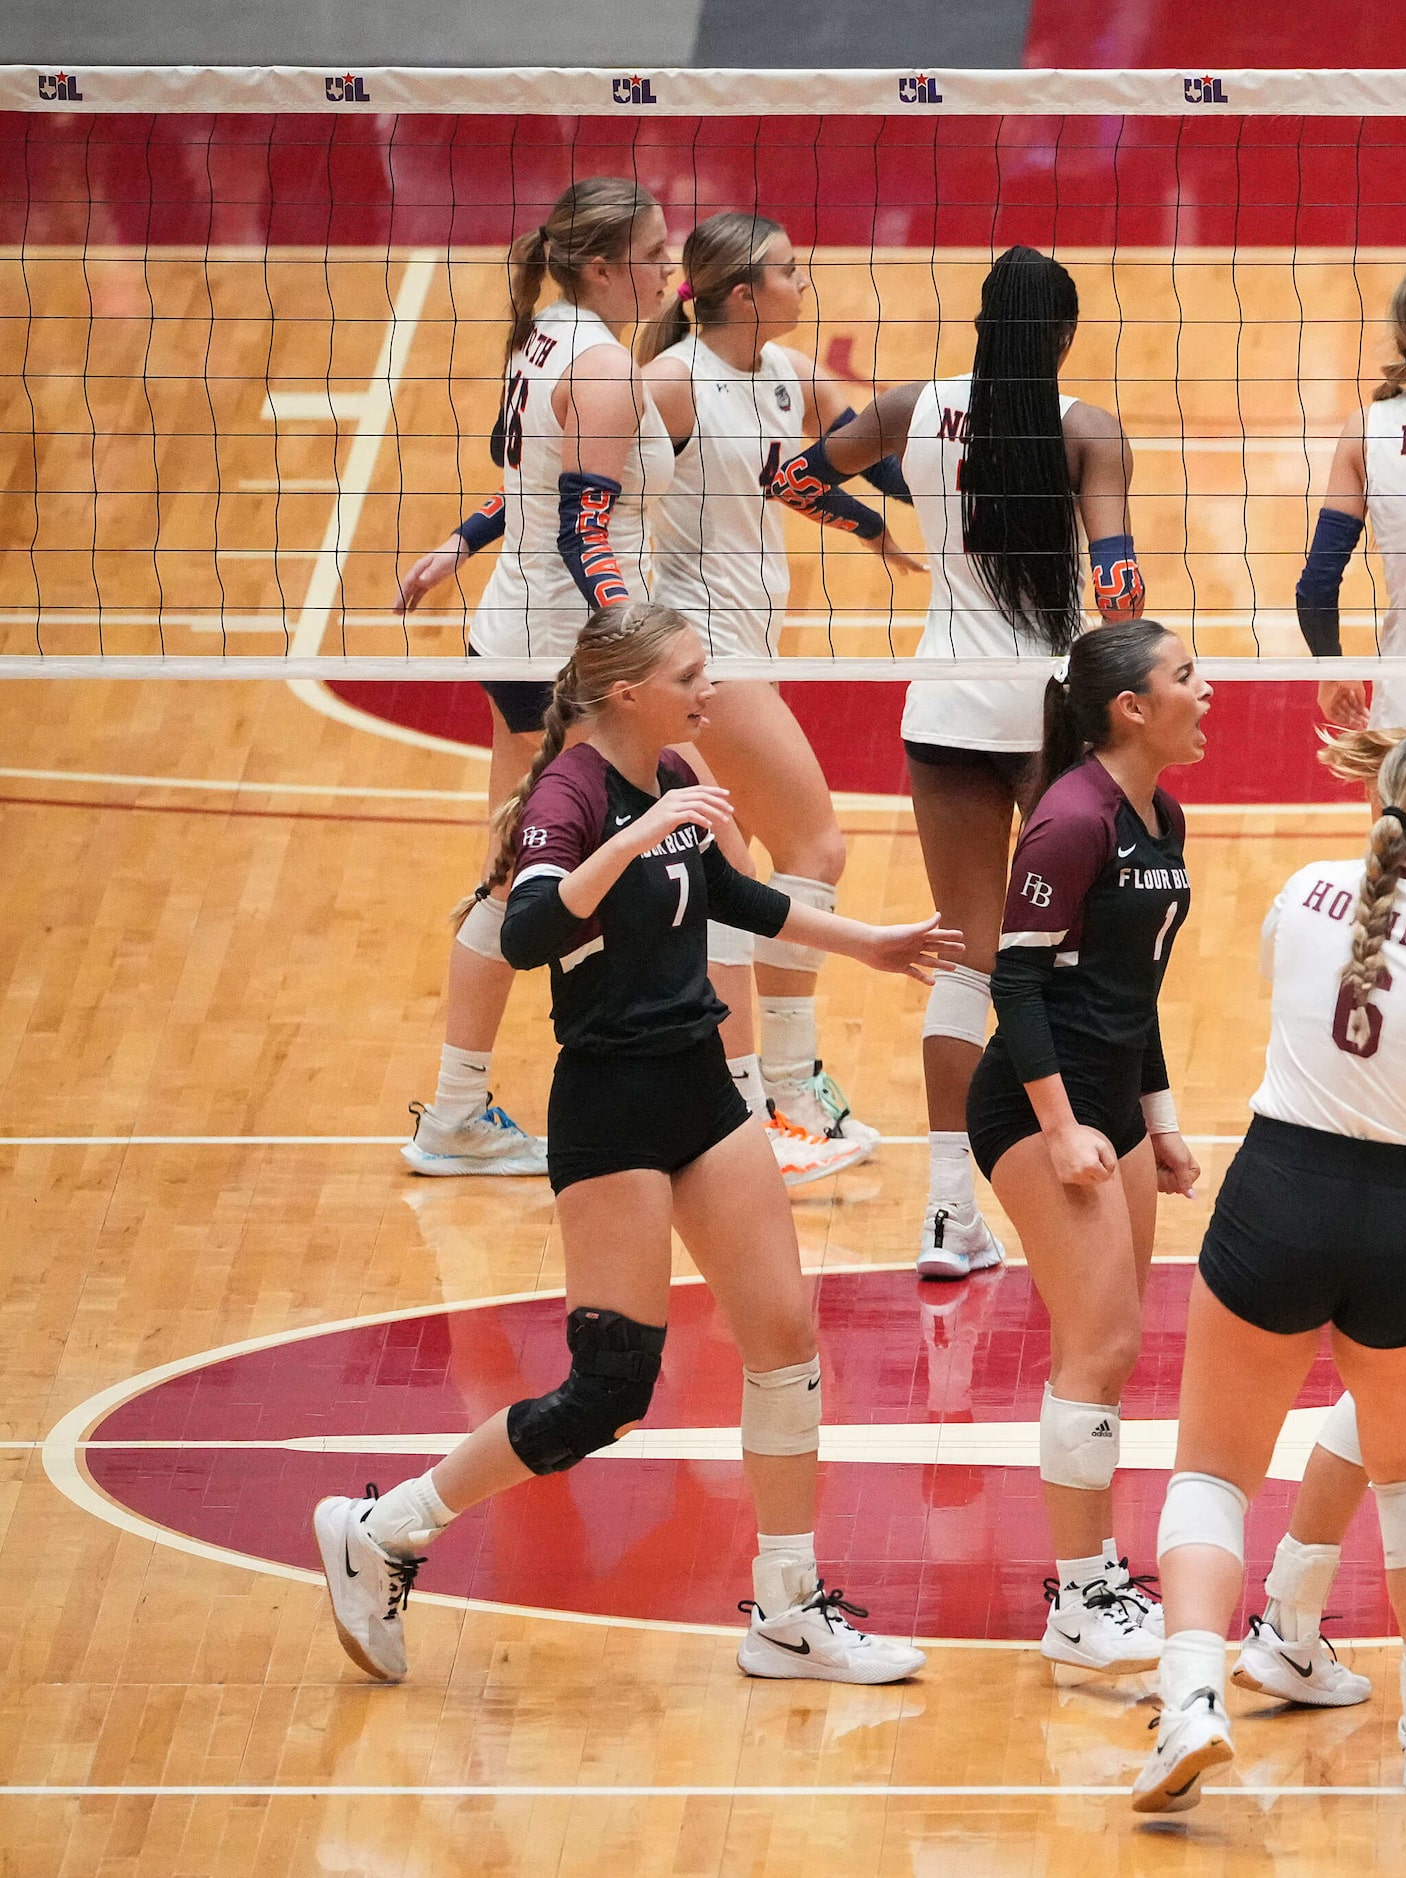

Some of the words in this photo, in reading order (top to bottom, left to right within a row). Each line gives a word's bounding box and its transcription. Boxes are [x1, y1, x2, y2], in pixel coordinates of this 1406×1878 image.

[522, 825, 548, 848] FB
[664, 862, 690, 928] 7
[1020, 871, 1054, 909] FB
[1118, 867, 1173, 890] FLOUR
[1153, 901, 1179, 961] 1
[1331, 966, 1393, 1059] 6
